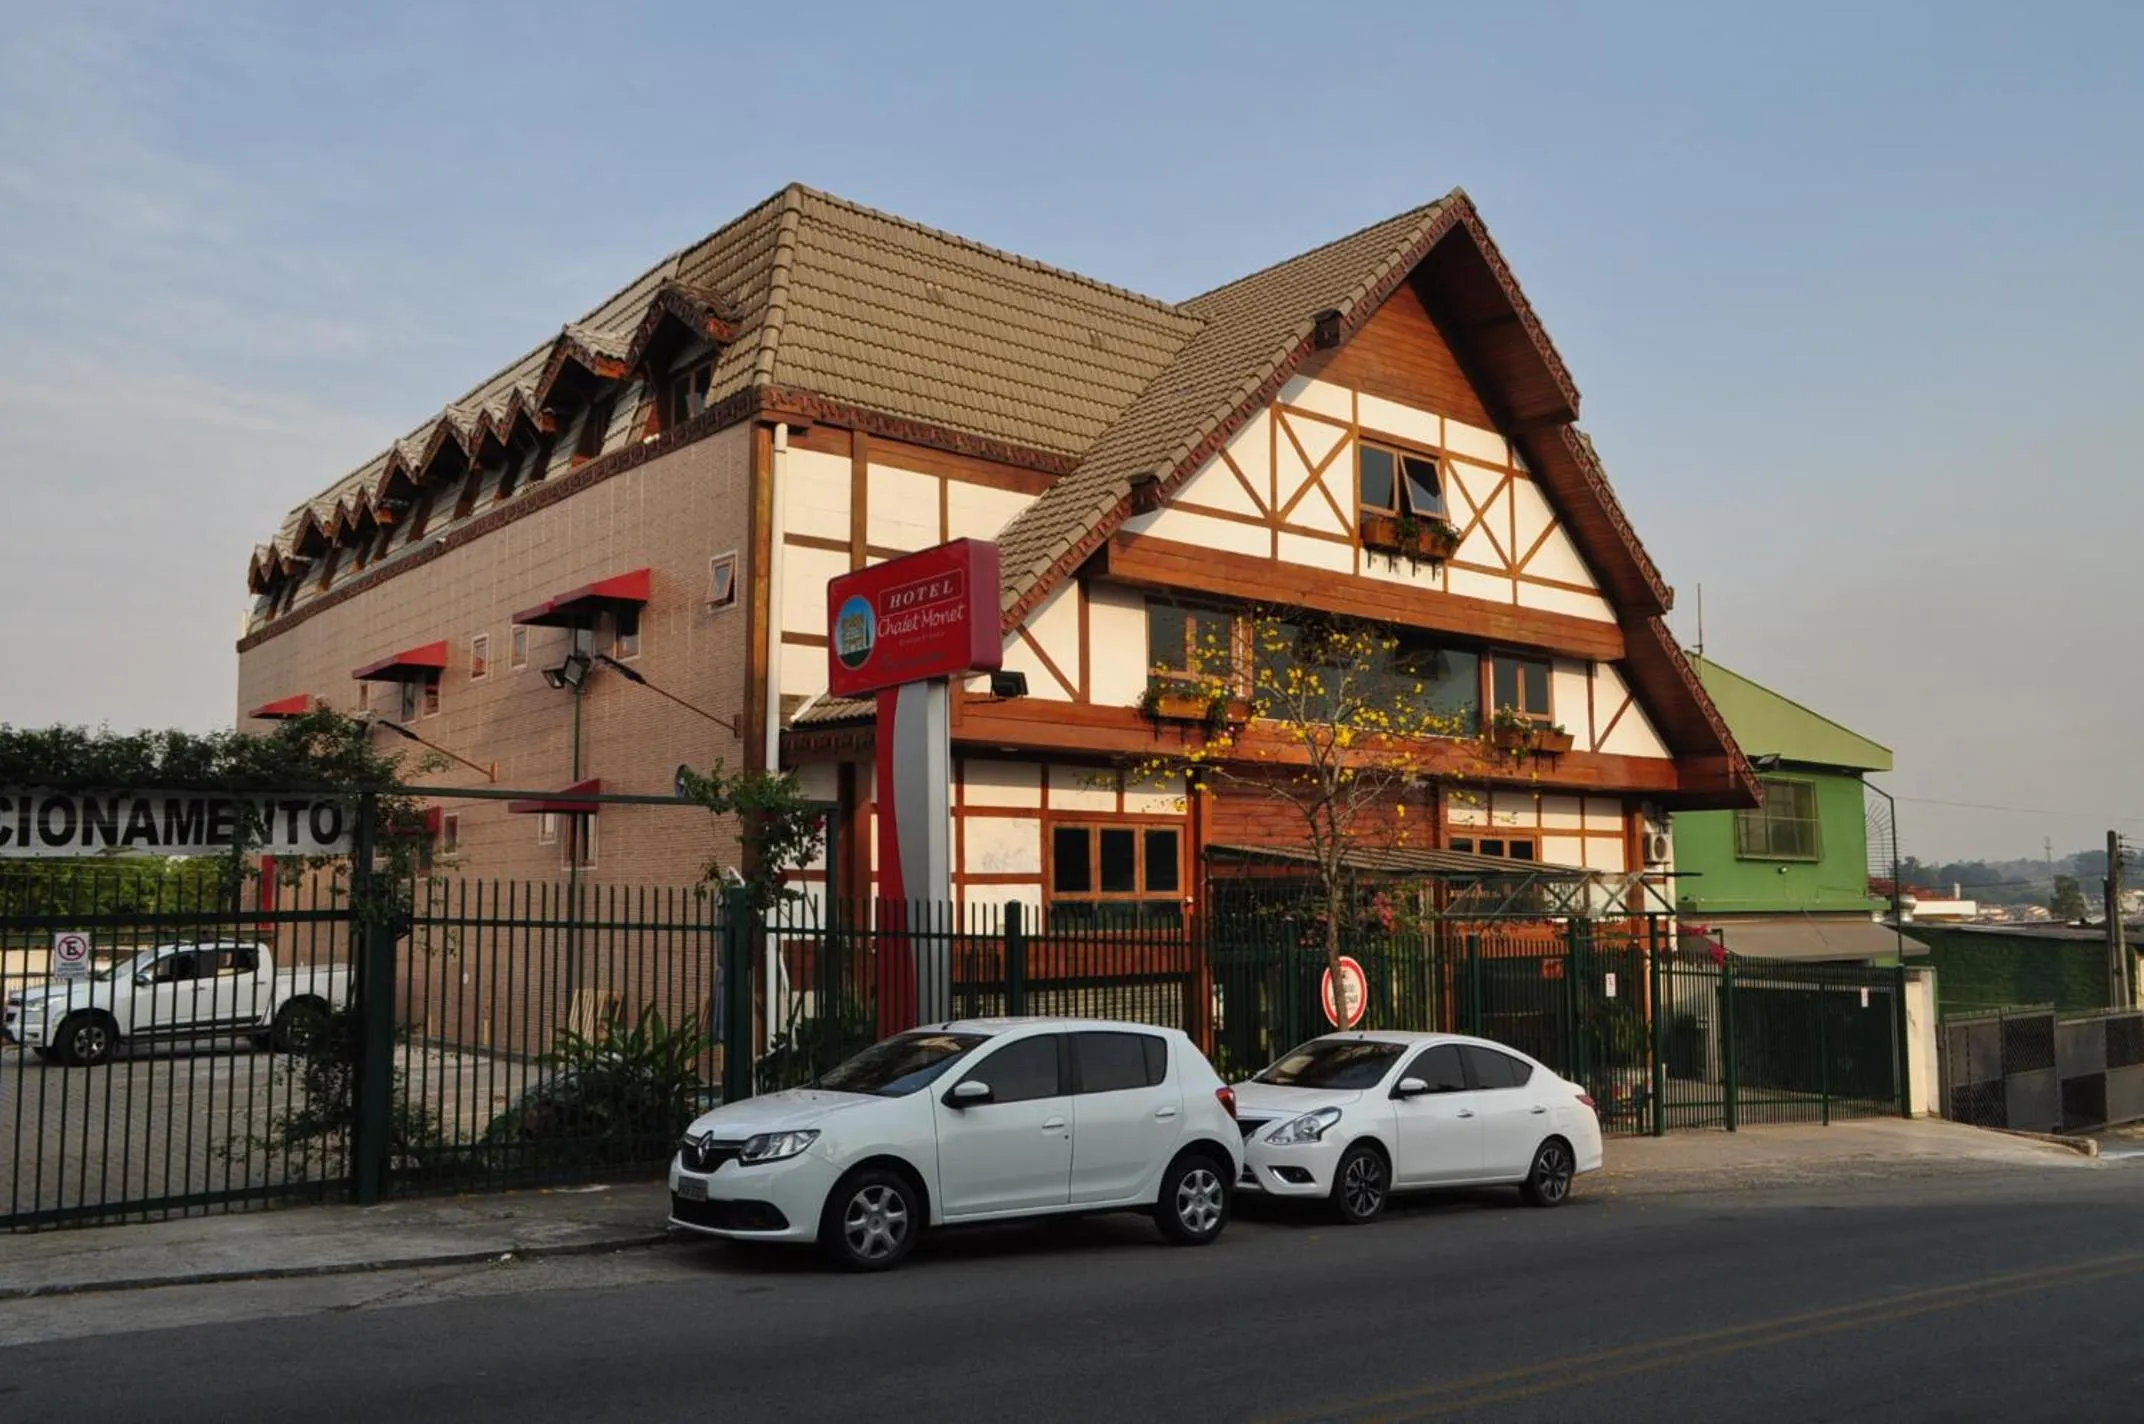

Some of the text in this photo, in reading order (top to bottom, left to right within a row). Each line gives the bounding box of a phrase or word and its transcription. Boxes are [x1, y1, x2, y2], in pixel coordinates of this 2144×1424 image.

[889, 579, 954, 609] HOTEL
[877, 603, 967, 638] Chalet Monet
[66, 940, 78, 956] E
